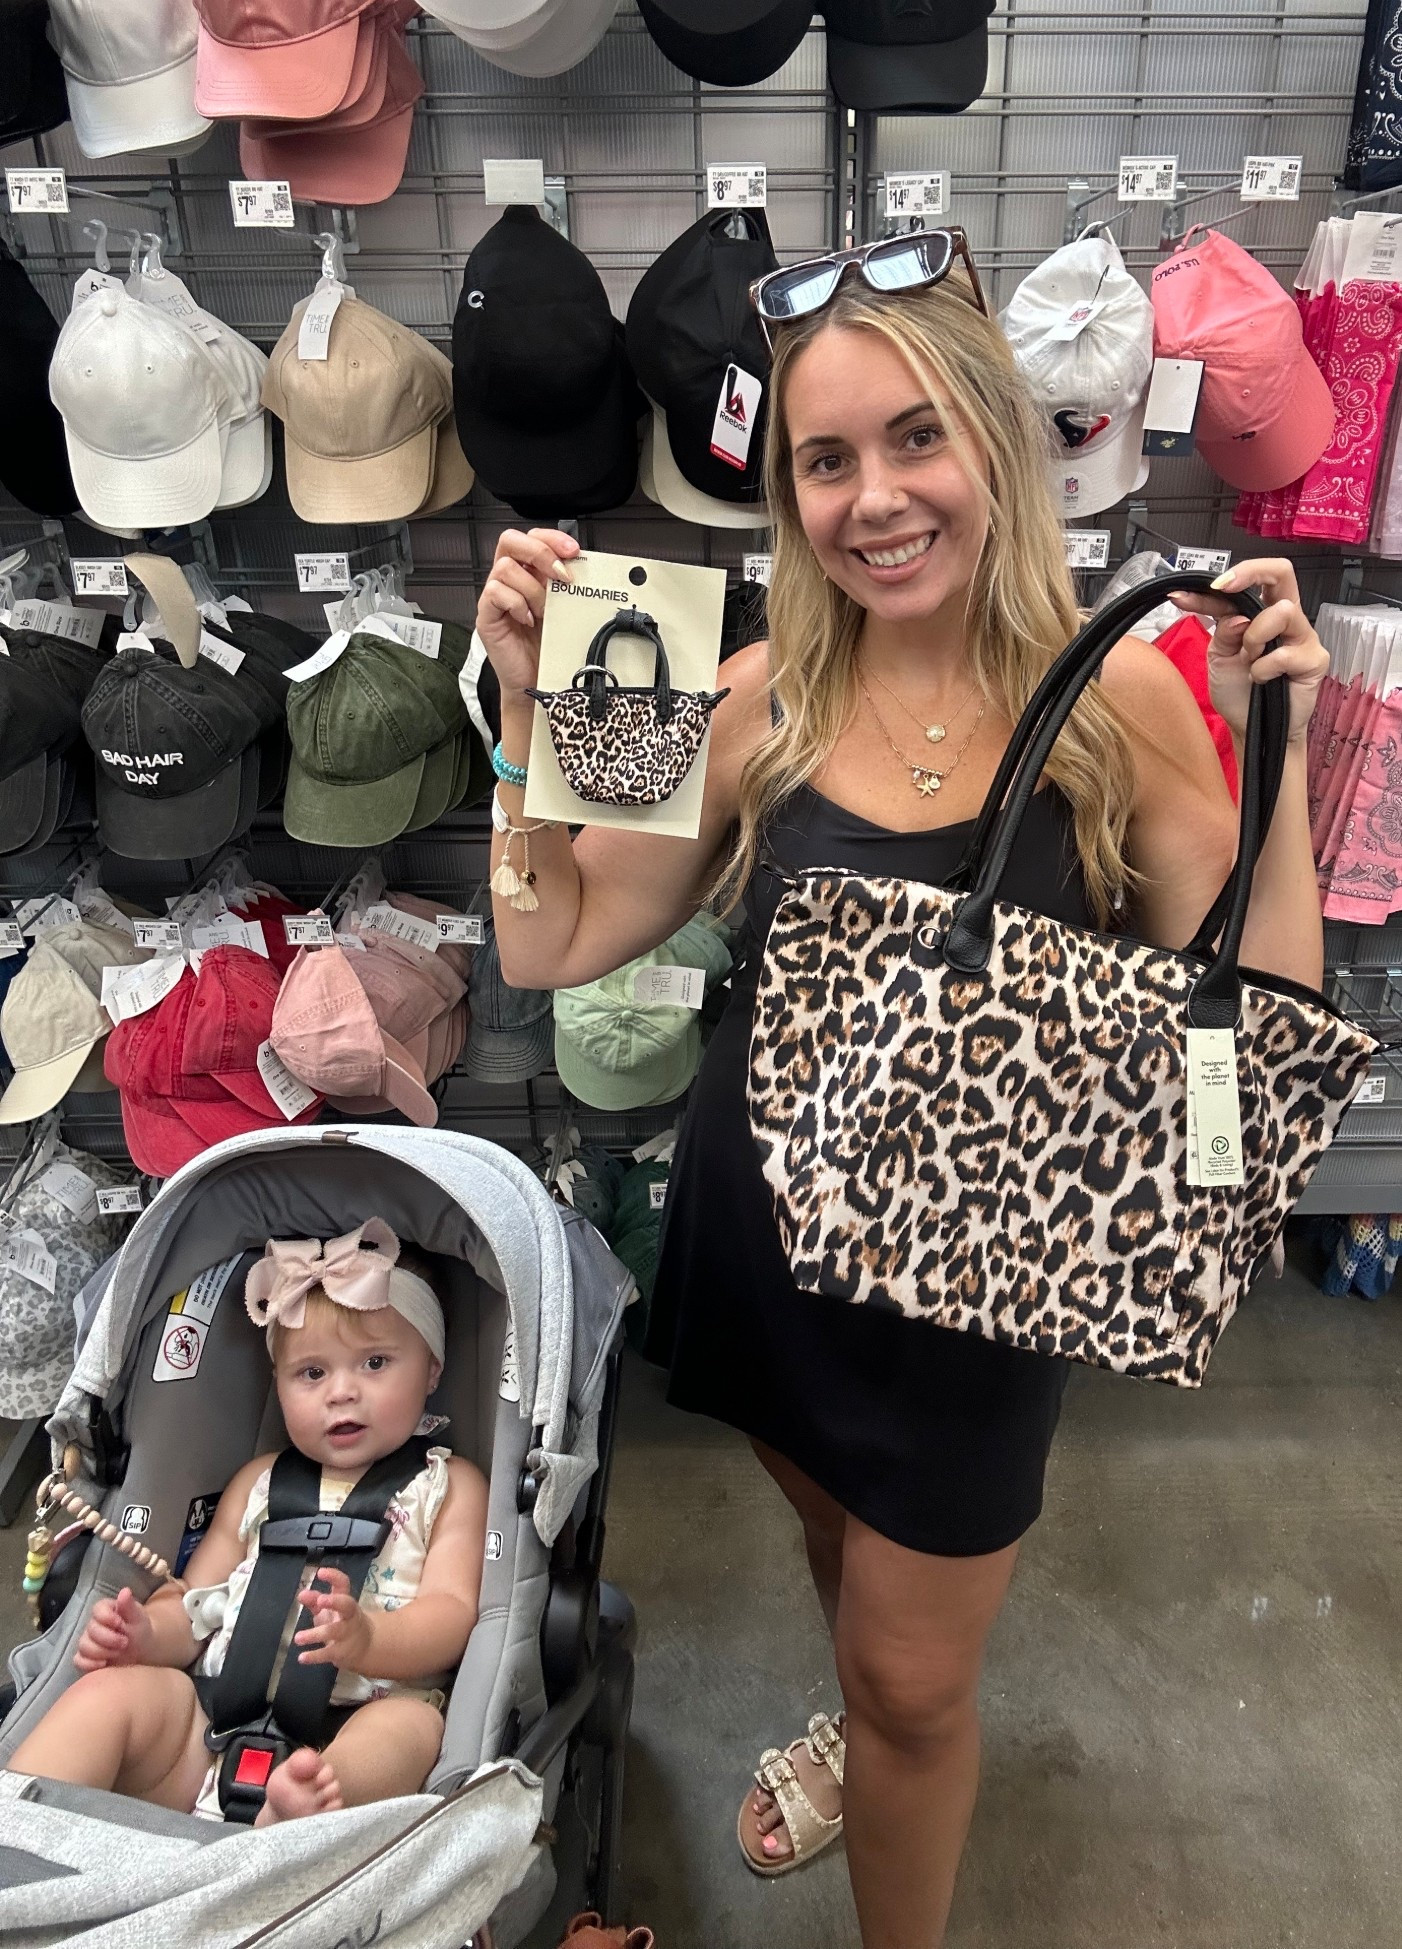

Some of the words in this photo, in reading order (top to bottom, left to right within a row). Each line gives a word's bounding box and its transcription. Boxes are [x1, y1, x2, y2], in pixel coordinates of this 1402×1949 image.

[720, 410, 747, 432] Reebok
[551, 582, 629, 602] BOUNDARIES
[102, 750, 133, 766] BAD
[136, 752, 184, 768] HAIR
[125, 770, 160, 785] DAY
[1201, 1060, 1228, 1068] Designed
